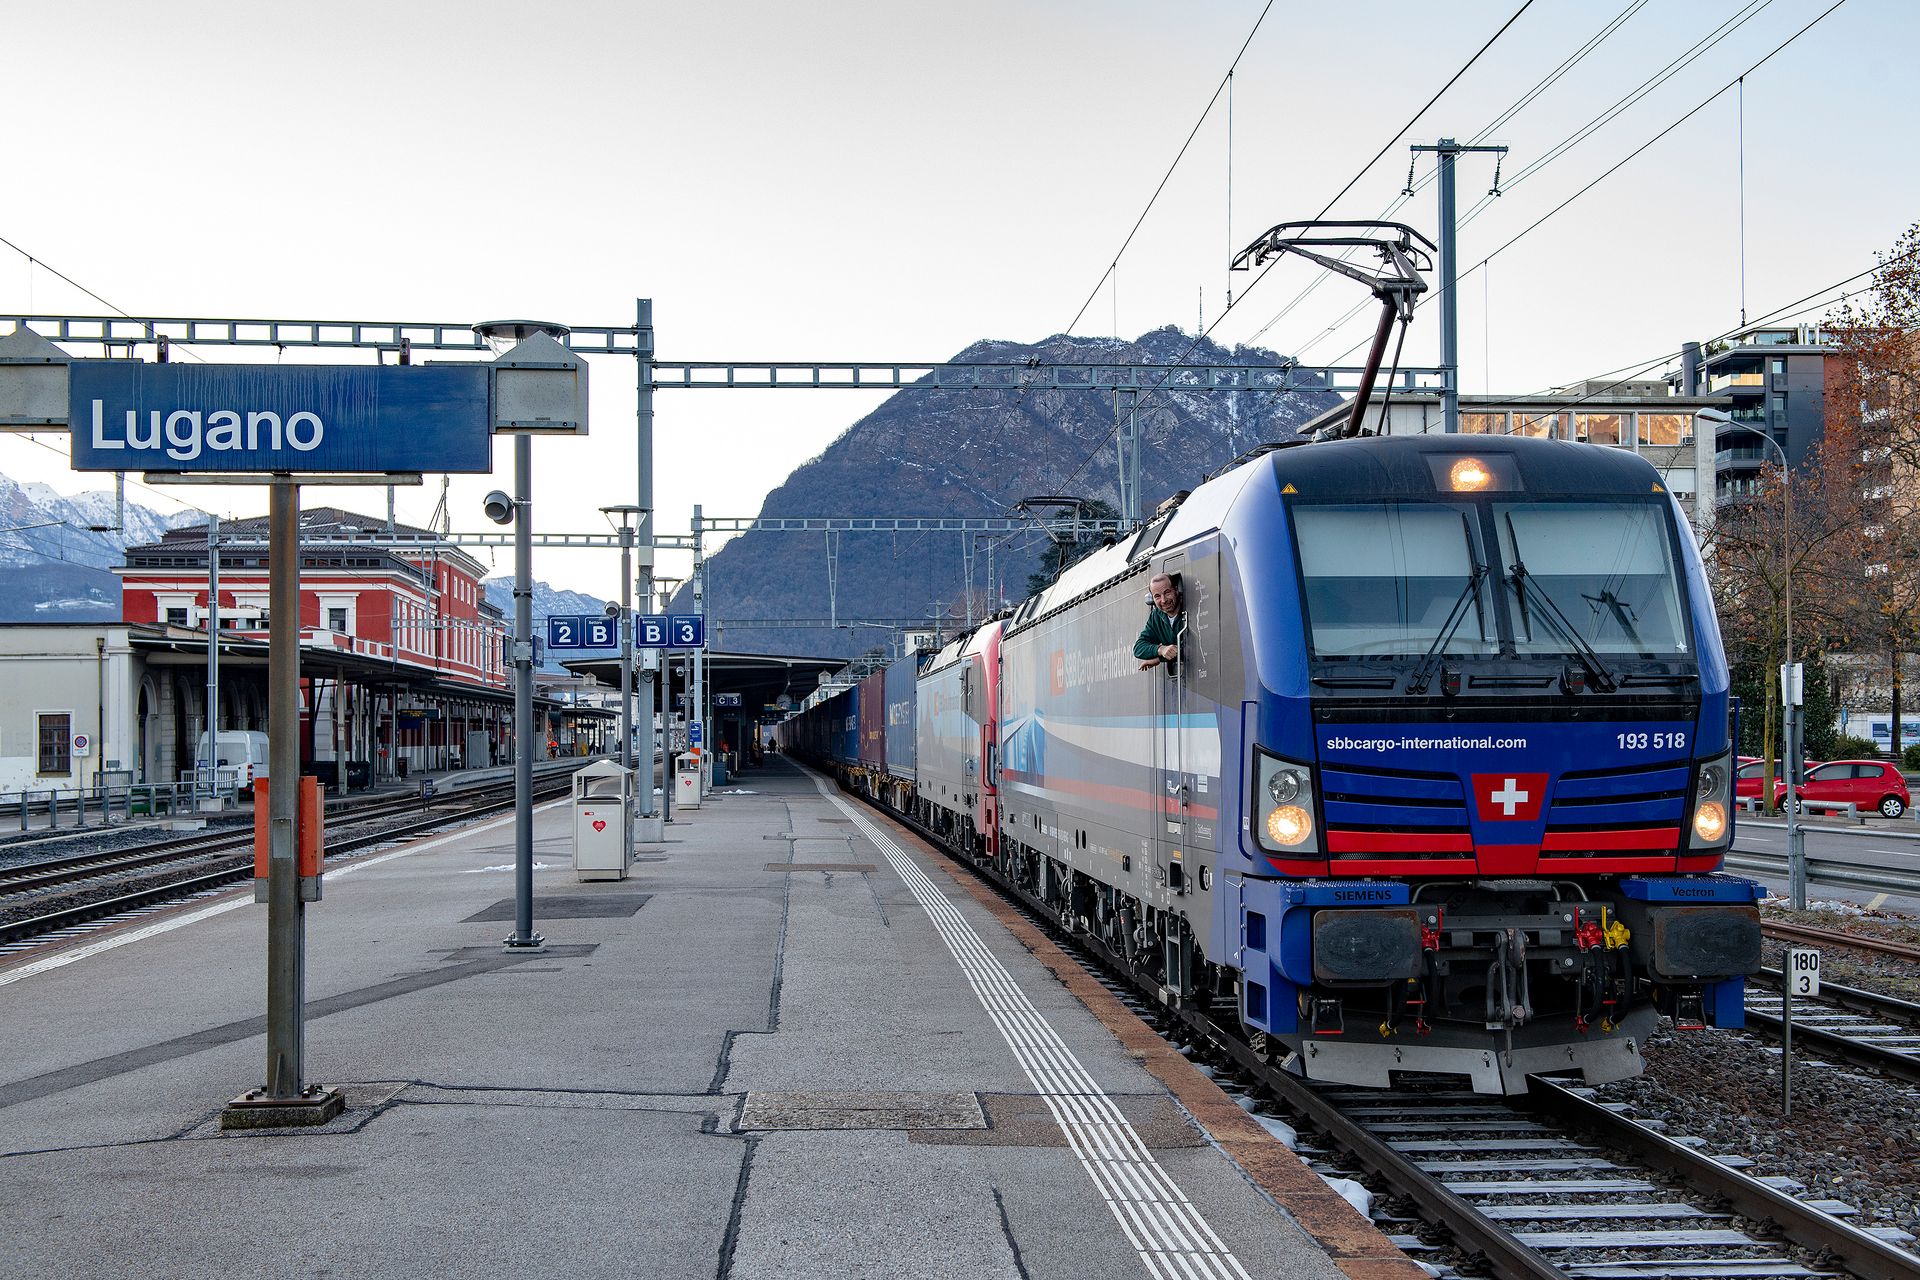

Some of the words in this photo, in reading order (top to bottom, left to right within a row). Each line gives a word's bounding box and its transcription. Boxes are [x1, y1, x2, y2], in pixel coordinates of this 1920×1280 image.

[92, 399, 324, 461] Lugano
[559, 626, 571, 642] 2
[593, 626, 607, 642] B
[646, 625, 661, 642] B
[681, 624, 694, 642] 3
[1077, 649, 1095, 693] Cargo
[719, 697, 726, 705] C
[732, 697, 738, 705] 3
[1326, 736, 1527, 752] sbbcargo-international.com
[1617, 733, 1648, 749] 193
[1653, 732, 1686, 749] 518
[1334, 889, 1392, 901] SIEMENS
[1671, 886, 1715, 897] Vectron
[1793, 952, 1819, 971] 180
[1799, 975, 1811, 994] 3
